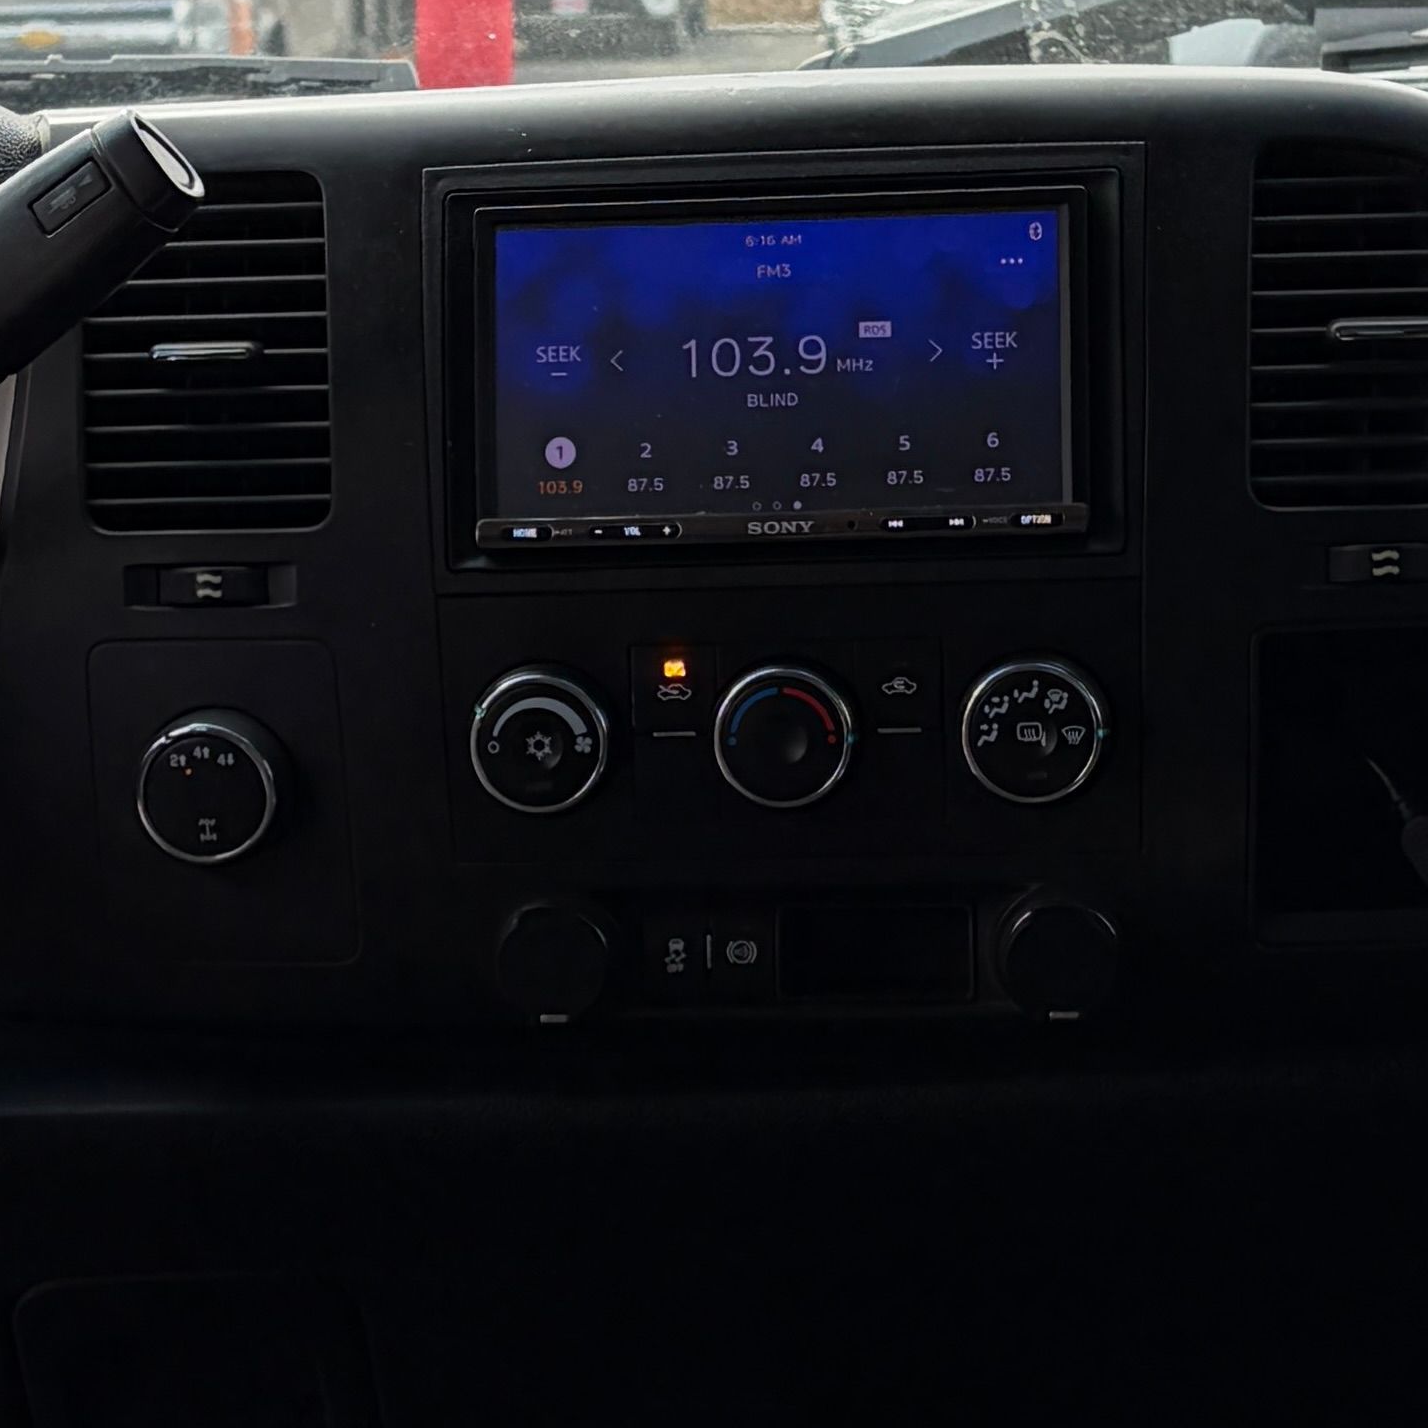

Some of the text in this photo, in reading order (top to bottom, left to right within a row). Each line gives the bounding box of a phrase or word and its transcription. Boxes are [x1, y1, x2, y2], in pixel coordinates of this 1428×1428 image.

[781, 233, 803, 246] AM
[756, 263, 792, 279] FM3
[971, 331, 1018, 350] SEEK
[535, 345, 582, 363] SEEK
[681, 335, 874, 378] 103.9 MHz
[747, 392, 799, 408] BLIND
[726, 440, 739, 456] 3
[810, 437, 824, 453] 4
[898, 435, 911, 451] 5
[986, 432, 1000, 448] 6
[639, 442, 653, 459] 2
[713, 475, 750, 490] 87.5
[799, 473, 837, 488] 87.5
[886, 470, 924, 485] 87.5
[974, 467, 1012, 483] 87.5
[538, 479, 584, 495] 103.9
[627, 478, 664, 493] 87.5
[747, 521, 815, 535] SONY
